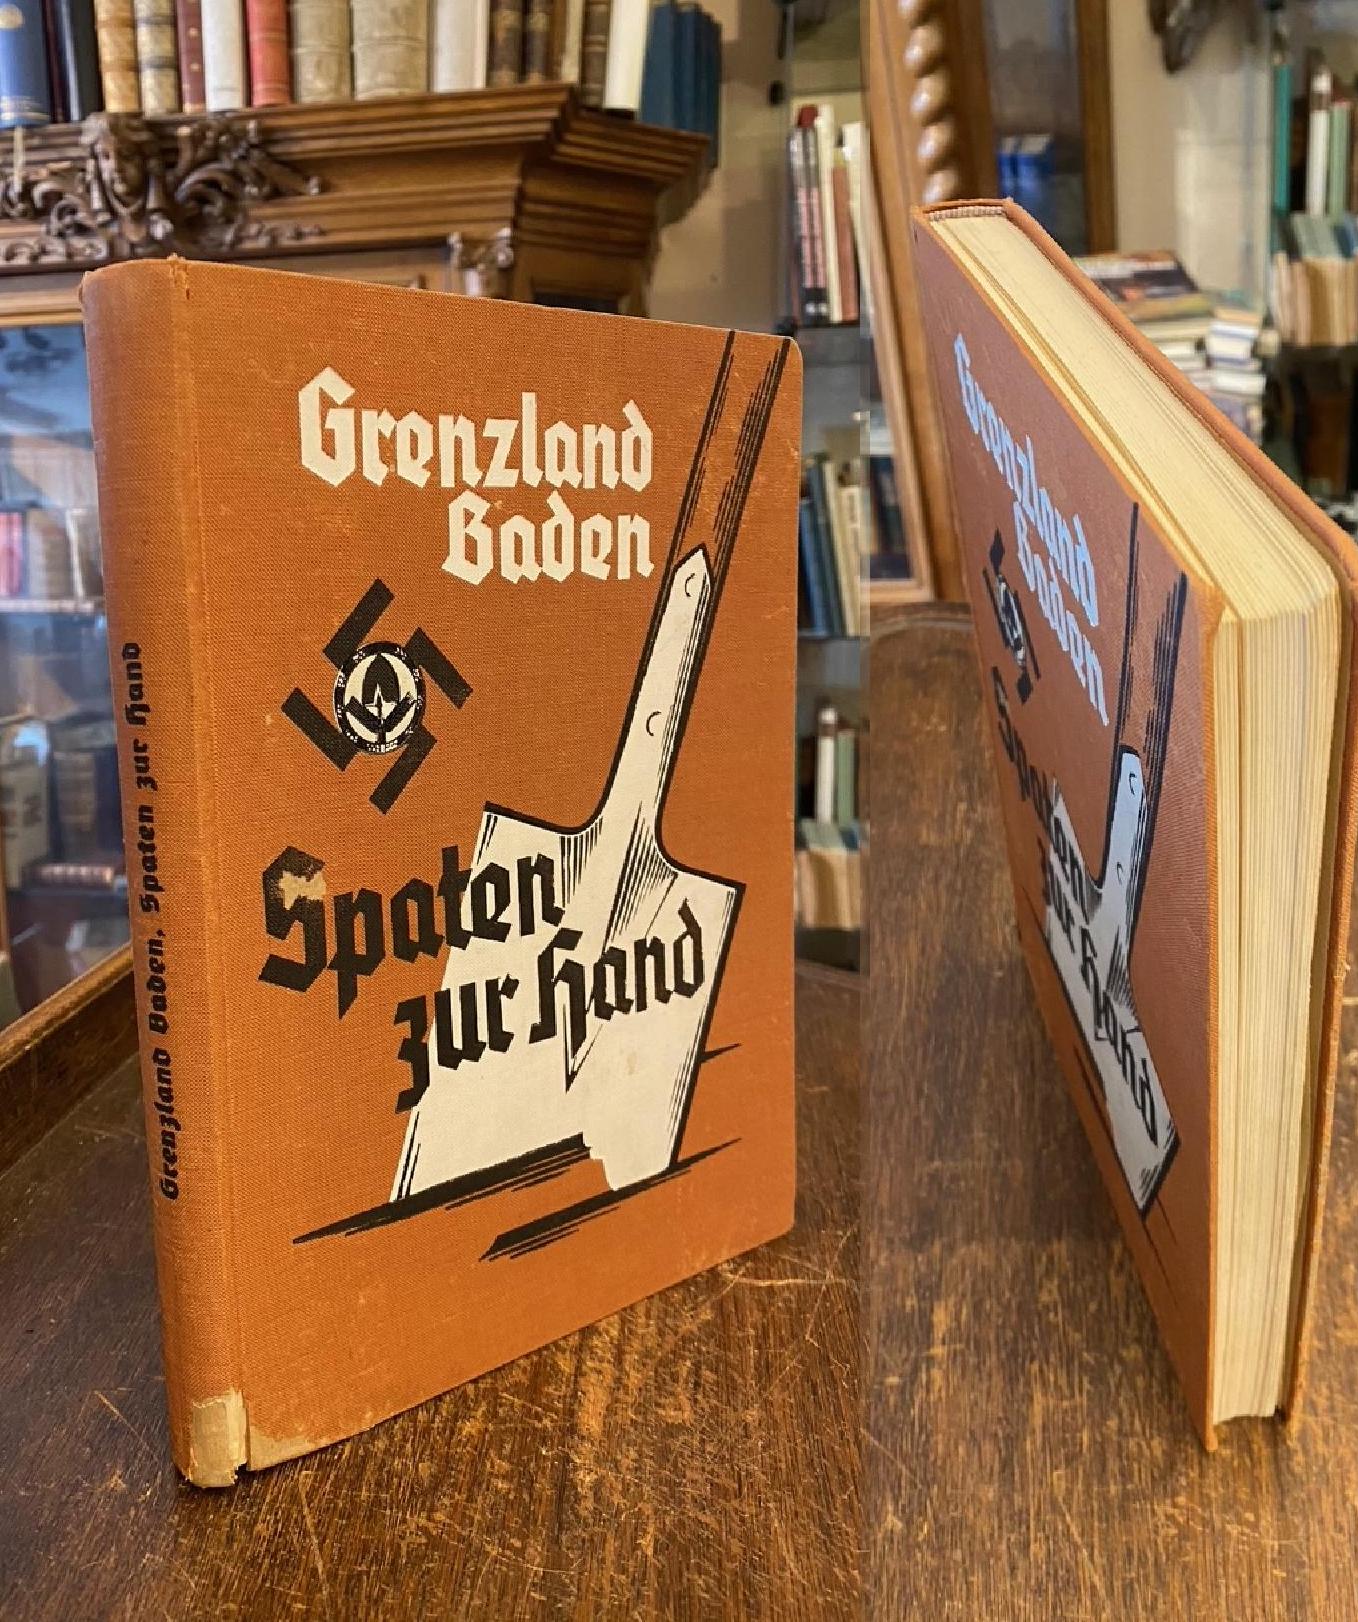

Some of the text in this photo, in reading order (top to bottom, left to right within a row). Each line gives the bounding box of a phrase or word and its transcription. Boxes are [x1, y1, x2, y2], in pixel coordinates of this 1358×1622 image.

[299, 366, 654, 492] Grenzland
[954, 332, 1099, 628] Grenzland
[441, 489, 655, 585] Baden
[1013, 500, 1109, 726] Baden
[122, 643, 150, 725] Hand
[133, 739, 158, 791] zur
[137, 804, 165, 912] Spaten
[259, 846, 565, 1020] Spaten
[394, 898, 705, 1114] zur Hand
[153, 1048, 181, 1200] Grenzland
